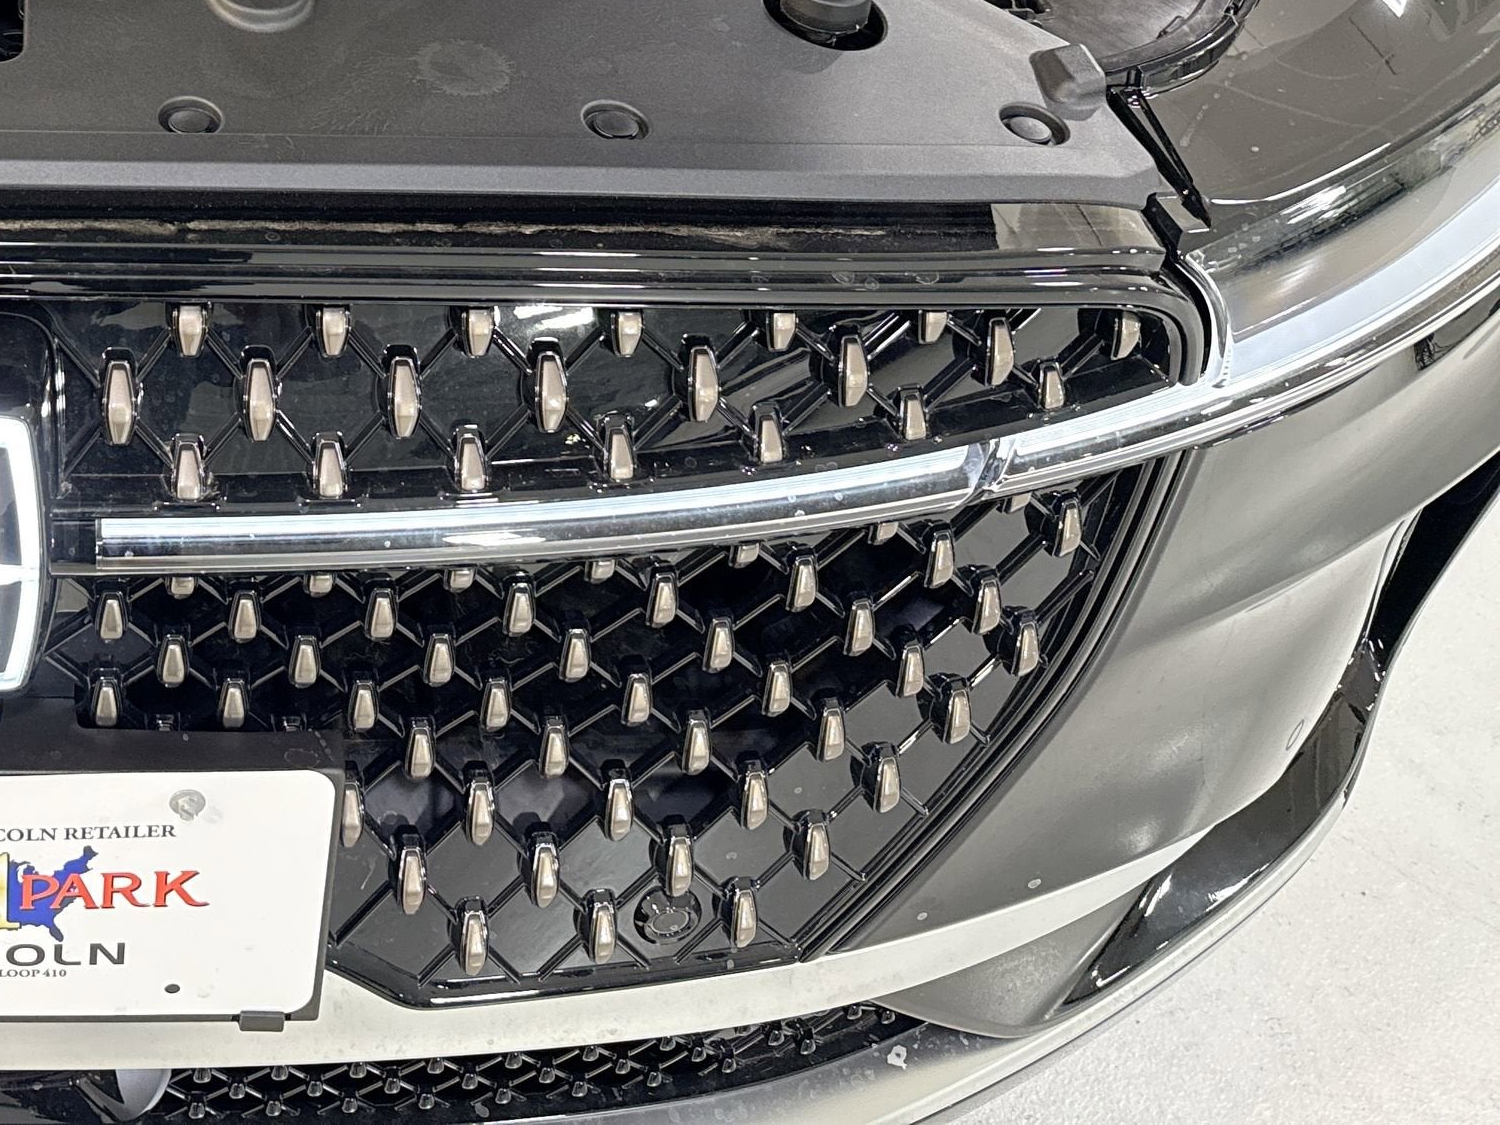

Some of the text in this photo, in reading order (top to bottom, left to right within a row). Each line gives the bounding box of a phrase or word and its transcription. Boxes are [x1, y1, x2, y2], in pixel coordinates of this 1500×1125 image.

[63, 824, 177, 841] RETAILER
[19, 868, 211, 911] PARK
[42, 968, 68, 978] 410
